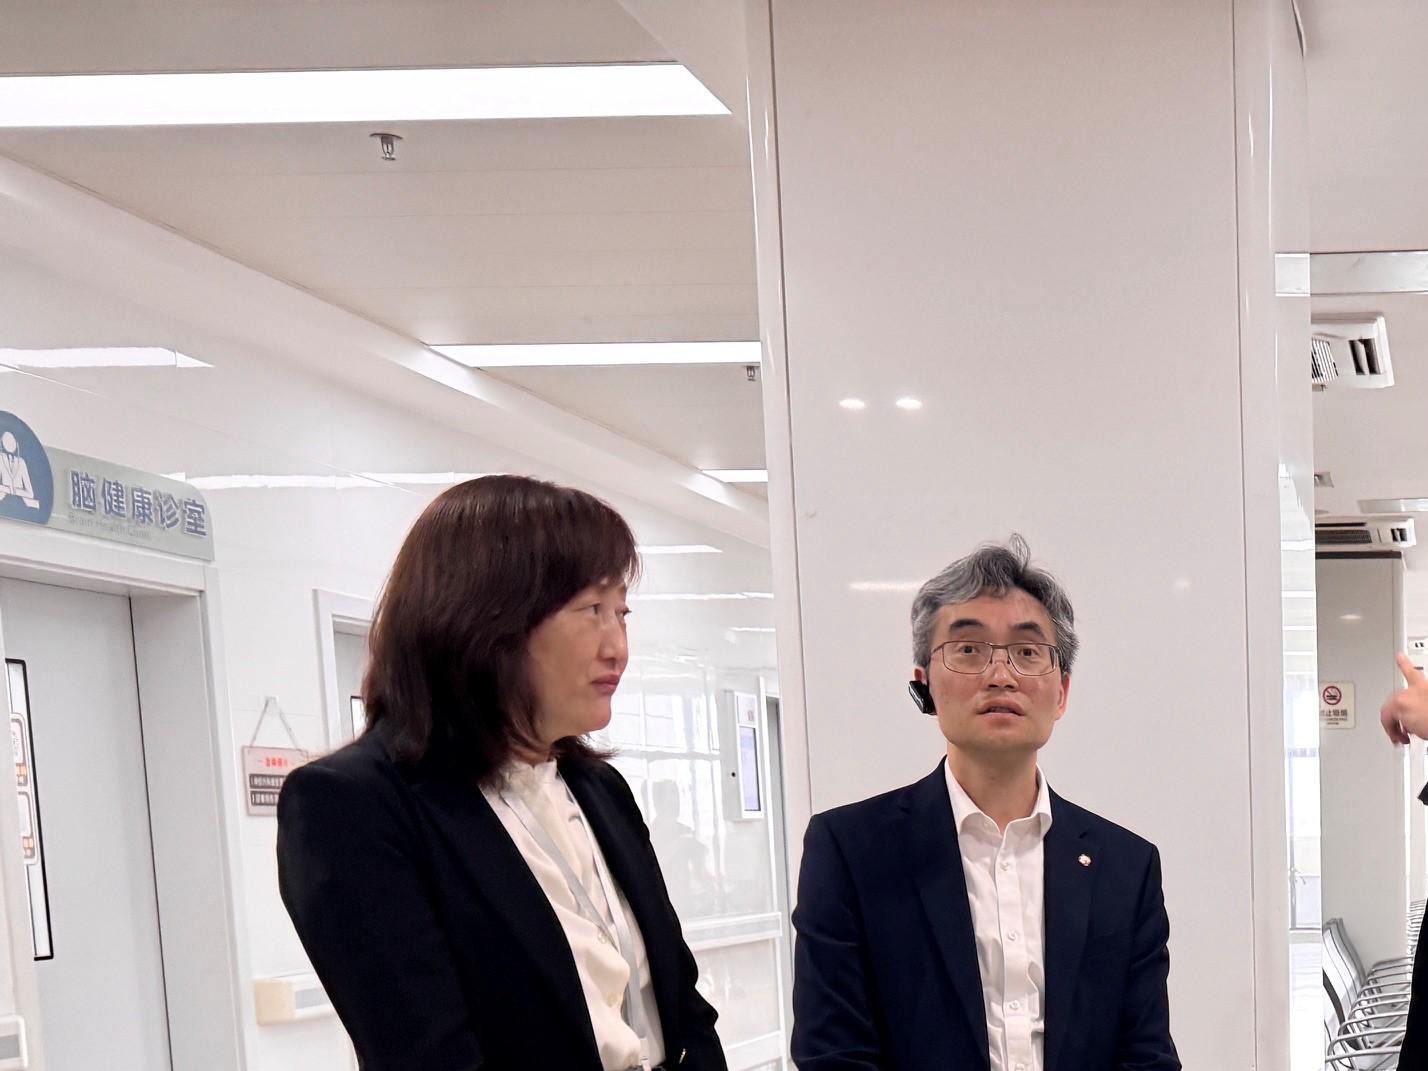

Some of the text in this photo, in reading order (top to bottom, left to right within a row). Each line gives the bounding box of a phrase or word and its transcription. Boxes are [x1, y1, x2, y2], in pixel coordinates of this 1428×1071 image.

[71, 470, 206, 537] 脑健康诊室
